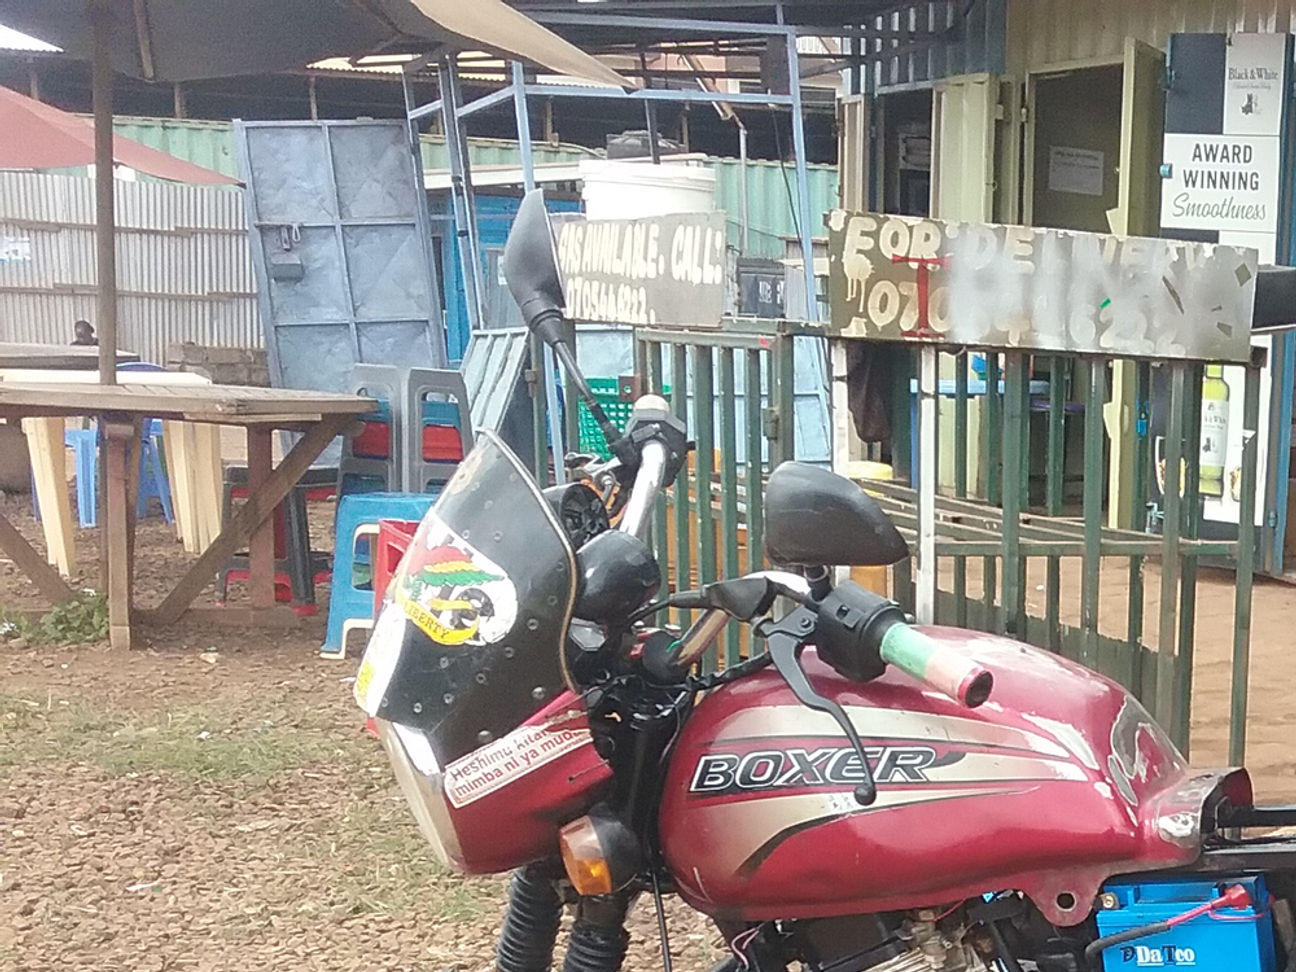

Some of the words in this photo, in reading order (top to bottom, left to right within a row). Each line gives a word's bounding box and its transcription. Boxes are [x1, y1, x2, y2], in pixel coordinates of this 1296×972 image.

[1192, 143, 1253, 164] AWARD
[1183, 169, 1260, 191] WINNING
[1172, 192, 1267, 220] Smoothness
[844, 216, 942, 272] FOR
[451, 747, 513, 781] Heshimu
[455, 768, 503, 797] mimba
[505, 757, 520, 773] ni
[520, 749, 540, 766] ya
[690, 747, 936, 792] BOXER
